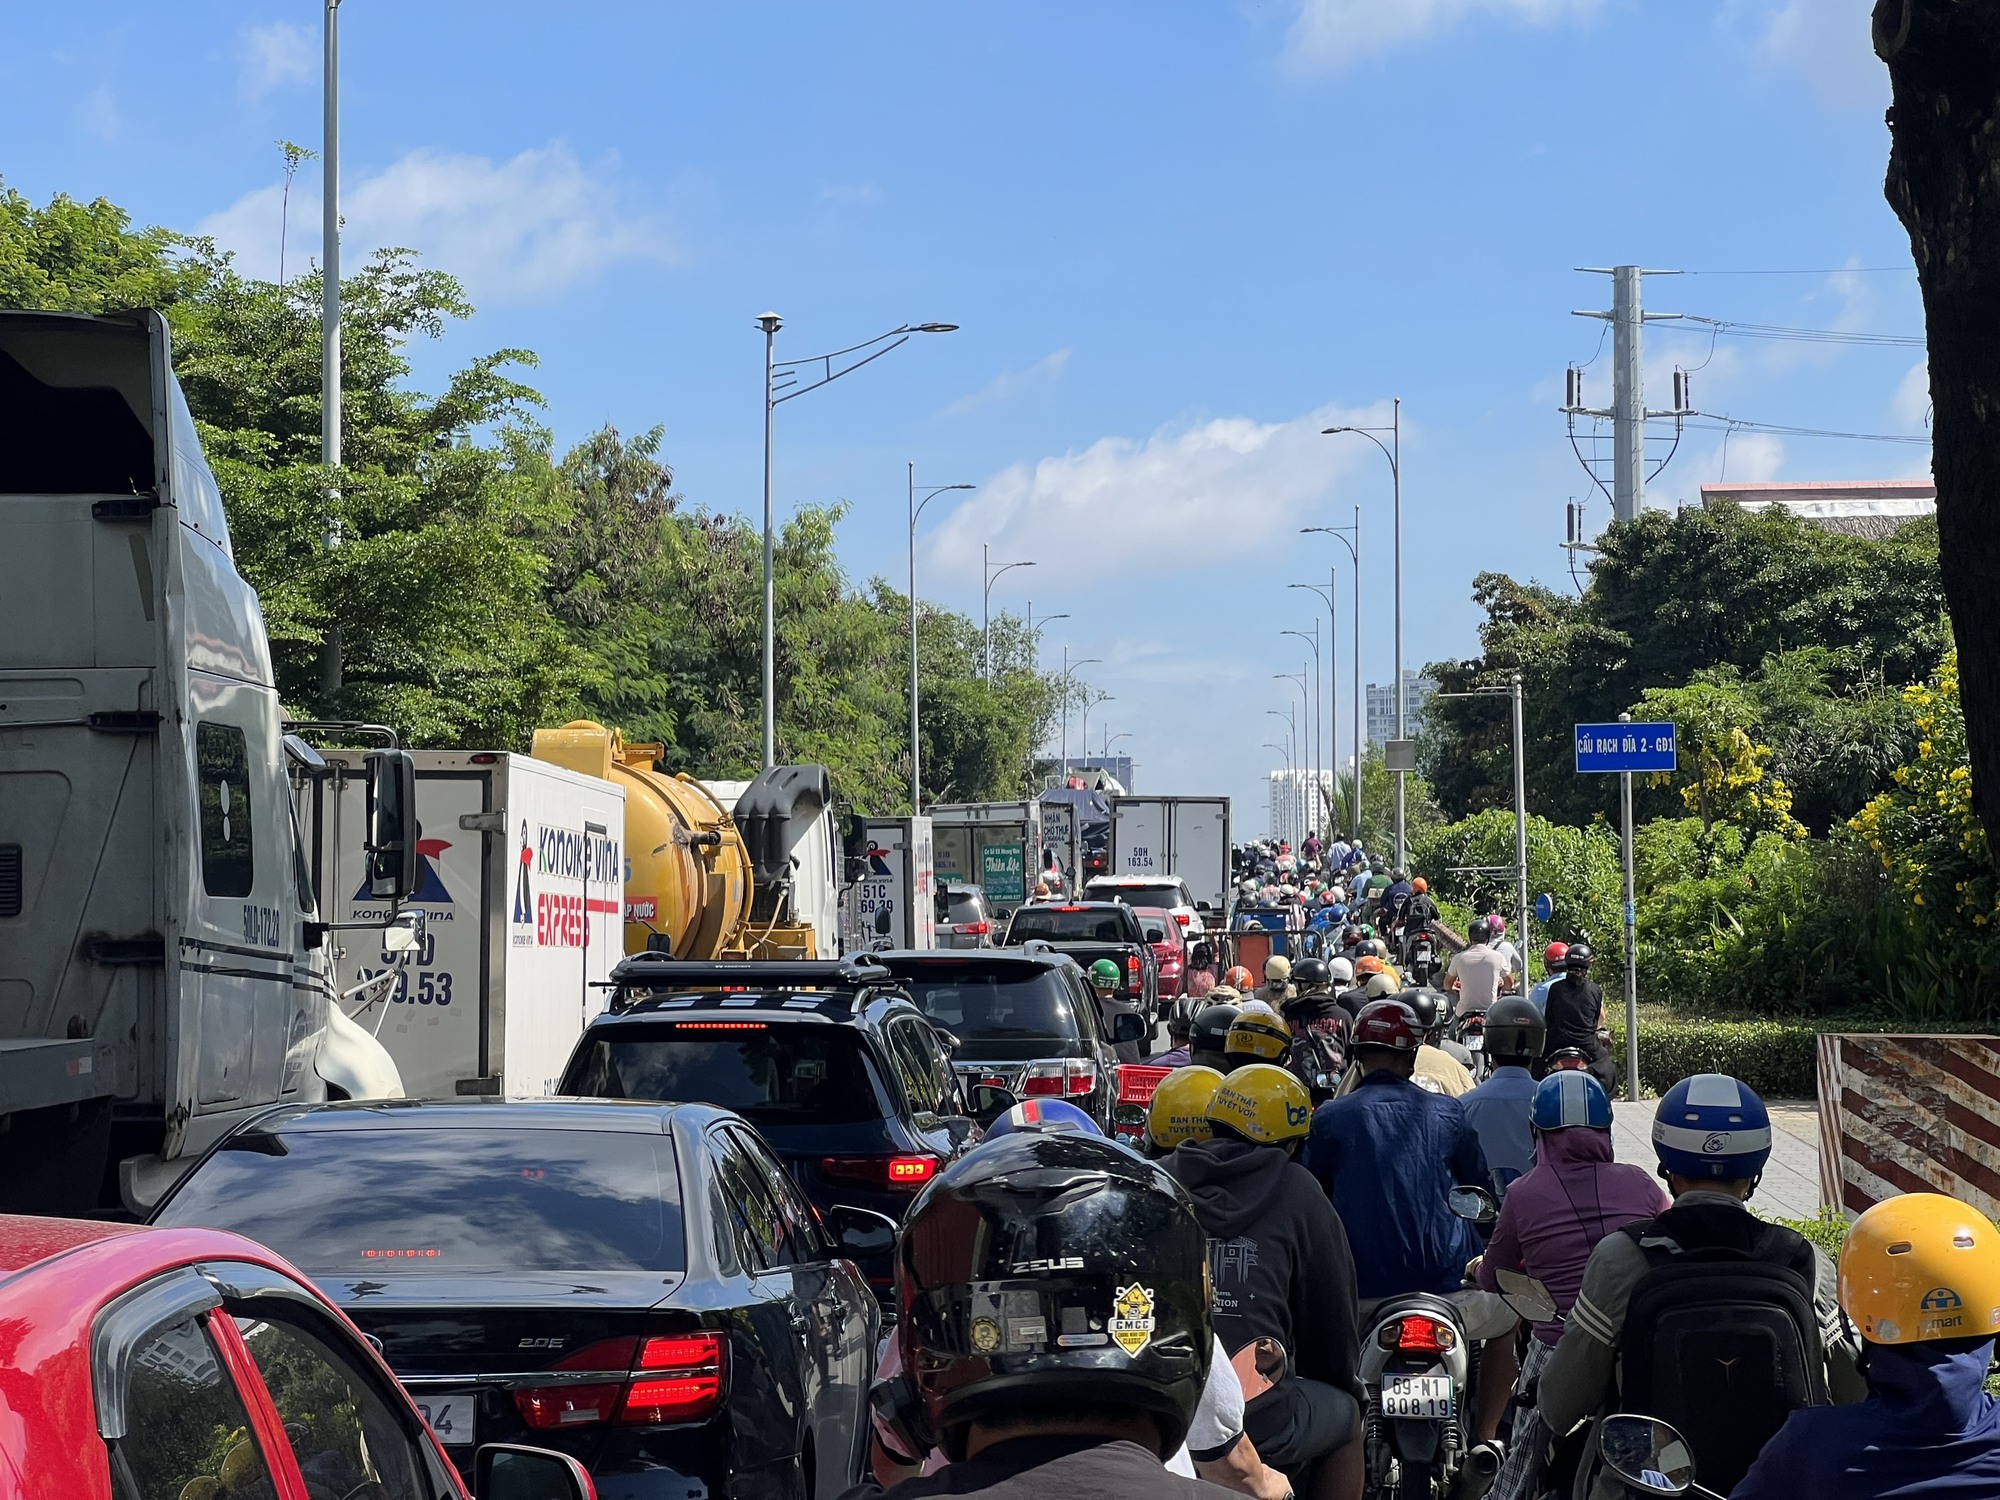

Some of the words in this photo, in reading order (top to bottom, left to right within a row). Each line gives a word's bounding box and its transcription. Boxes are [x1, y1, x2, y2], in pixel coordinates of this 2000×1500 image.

[1577, 732, 1593, 753] CẦU
[1596, 738, 1618, 755] RẠCH
[1622, 734, 1637, 752] ĐĨA
[1640, 738, 1647, 752] 2
[1133, 847, 1148, 857] 50H
[1128, 858, 1153, 867] 163.54
[863, 884, 886, 899] 51C
[633, 901, 655, 918] NƯỚC
[1285, 1101, 1308, 1126] be
[1012, 1257, 1085, 1274] ZEUS
[1392, 1377, 1439, 1396] 69-N1
[1386, 1397, 1448, 1417] 808.19
